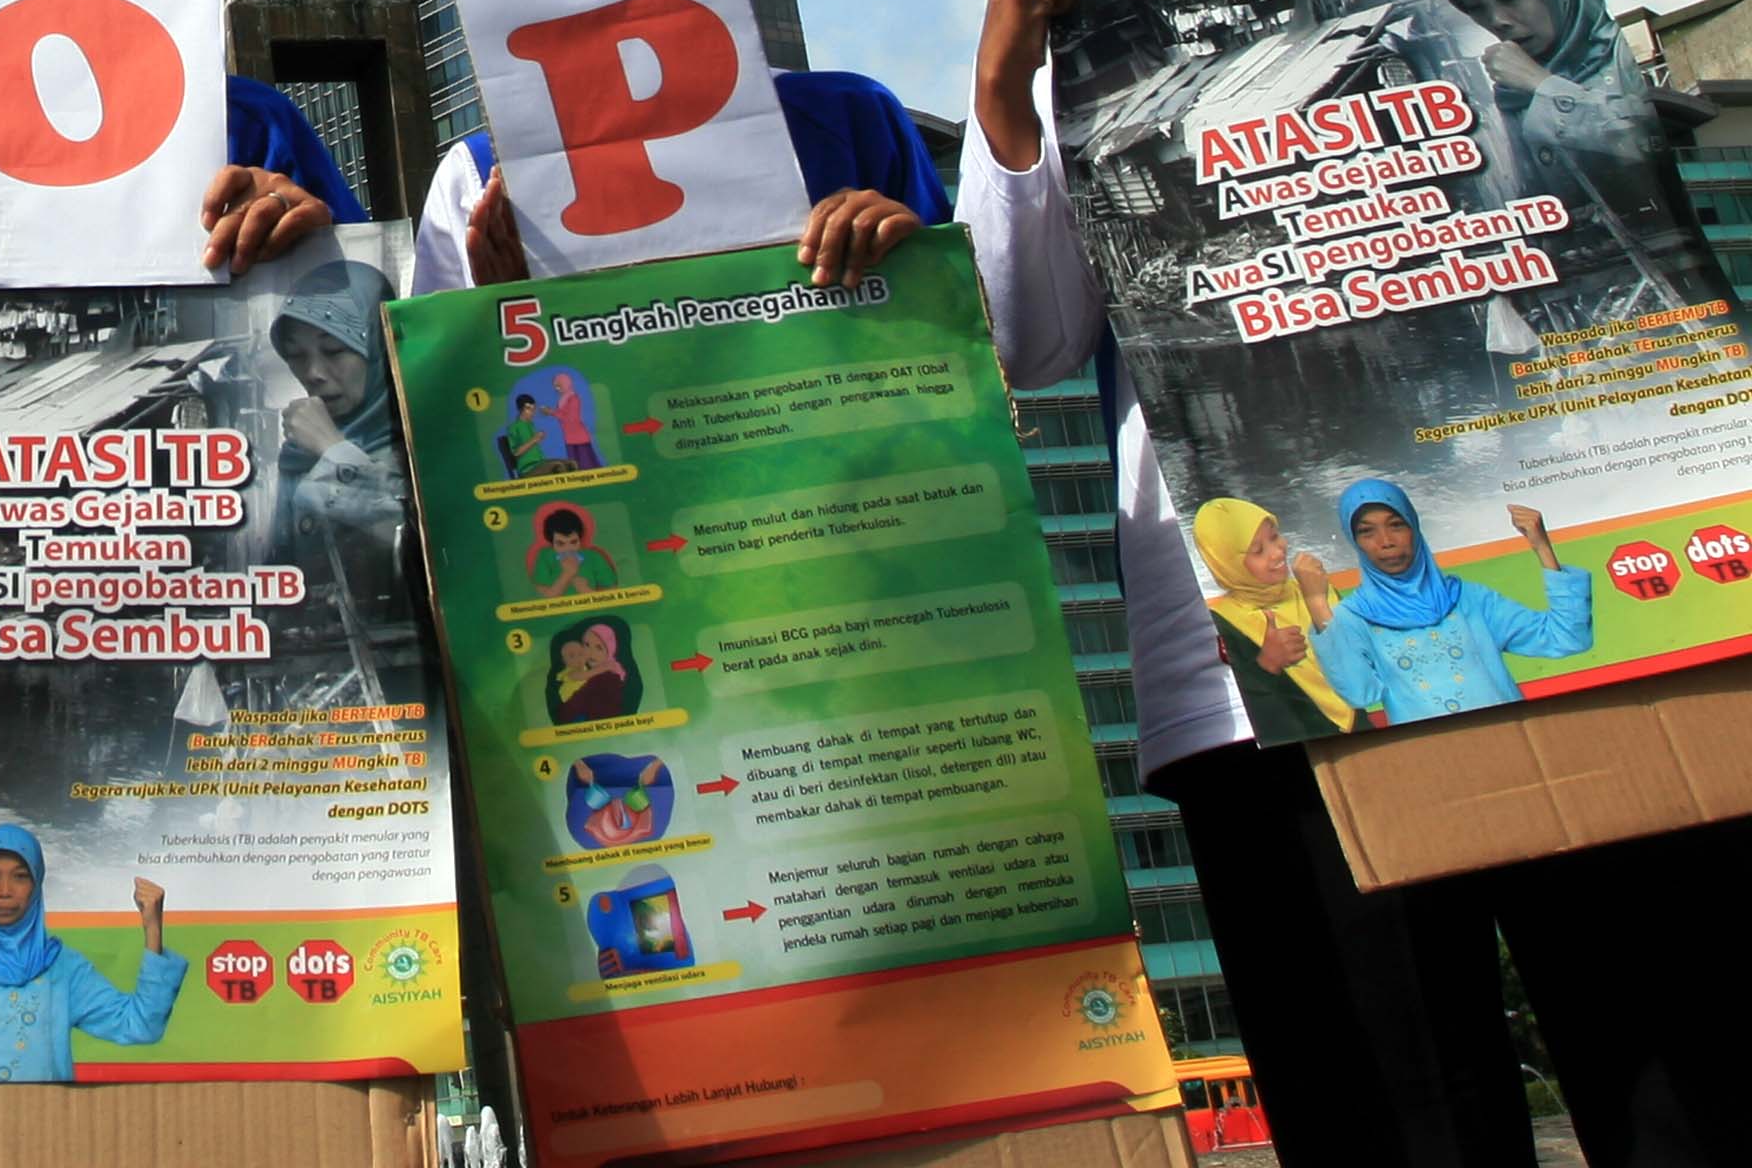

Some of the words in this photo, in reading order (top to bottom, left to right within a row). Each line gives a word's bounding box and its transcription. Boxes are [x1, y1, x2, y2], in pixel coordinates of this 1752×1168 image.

[1201, 103, 1376, 178] ATASI
[1377, 85, 1467, 136] TB
[1225, 174, 1312, 213] Awas
[1318, 152, 1426, 190] Gejala
[1431, 141, 1475, 169] TB
[1282, 190, 1443, 236] Temukan
[1191, 251, 1295, 296] AwaSI
[1303, 215, 1513, 275] pengobatan
[1514, 200, 1562, 228] TB
[1236, 288, 1340, 337] Bisa
[1348, 246, 1548, 312] Sembuh
[503, 300, 547, 363] 5
[556, 307, 674, 341] Langkah
[684, 288, 846, 322] Pencegahan
[473, 393, 481, 406] 1
[162, 434, 245, 482] TB
[76, 494, 184, 527] Gejala
[194, 494, 237, 520] TB
[490, 512, 501, 525] 2
[694, 519, 748, 537] Menutup
[751, 512, 787, 527] mulut
[791, 508, 813, 521] dan
[818, 501, 859, 517] hidung
[863, 497, 891, 512] pada
[896, 492, 919, 505] saat
[924, 486, 958, 501] batuk
[961, 483, 984, 495] dan
[25, 535, 186, 561] Temukan
[698, 542, 735, 557] bersin
[738, 537, 765, 552] bagi
[768, 527, 825, 547] penderita
[828, 516, 906, 536] Tuberkulosis.
[1688, 534, 1750, 562] dots
[1612, 552, 1668, 577] stop
[1709, 559, 1749, 581] TB
[30, 571, 246, 607] pengobatan
[254, 572, 300, 599] TB
[1630, 576, 1670, 598] TB
[62, 614, 265, 653] Sembuh
[718, 634, 777, 652] Imunisasi
[781, 628, 808, 642] BCG
[812, 622, 842, 639] pada
[845, 619, 870, 633] bayi
[874, 611, 933, 629] mencegah
[936, 600, 1010, 620] Tuberkulosis
[512, 634, 523, 648] 3
[722, 659, 754, 673] berat
[758, 654, 788, 669] pada
[792, 648, 820, 662] anak
[824, 643, 855, 658] sejak
[859, 638, 887, 651] dini.
[230, 710, 298, 725] Waspada
[300, 709, 327, 724] jika
[330, 706, 402, 722] BERTEMU
[404, 705, 425, 718] TB
[188, 733, 236, 749] (Batuk
[239, 732, 314, 748] bERdahak
[318, 732, 359, 747] TErus
[361, 730, 425, 744] menerus
[186, 757, 224, 772] lebih
[227, 756, 256, 771] dari
[259, 758, 268, 770] 2
[272, 758, 329, 773] minggu
[332, 754, 399, 769] MUngkin
[402, 752, 427, 767] TB)
[540, 760, 551, 774] 4
[72, 784, 124, 800] Segera
[125, 783, 166, 799] rujuk
[168, 783, 186, 796] ke
[189, 783, 219, 796] UPK
[223, 782, 259, 798] (Unit
[262, 781, 341, 798] Pelayanan
[343, 777, 428, 795] Kesehatan)
[328, 804, 385, 821] dengan
[388, 800, 429, 816] DOTS
[558, 888, 570, 902] 5
[212, 953, 268, 977] stop
[289, 947, 351, 975] dots
[221, 980, 257, 1001] TB
[302, 979, 338, 1000] TB
